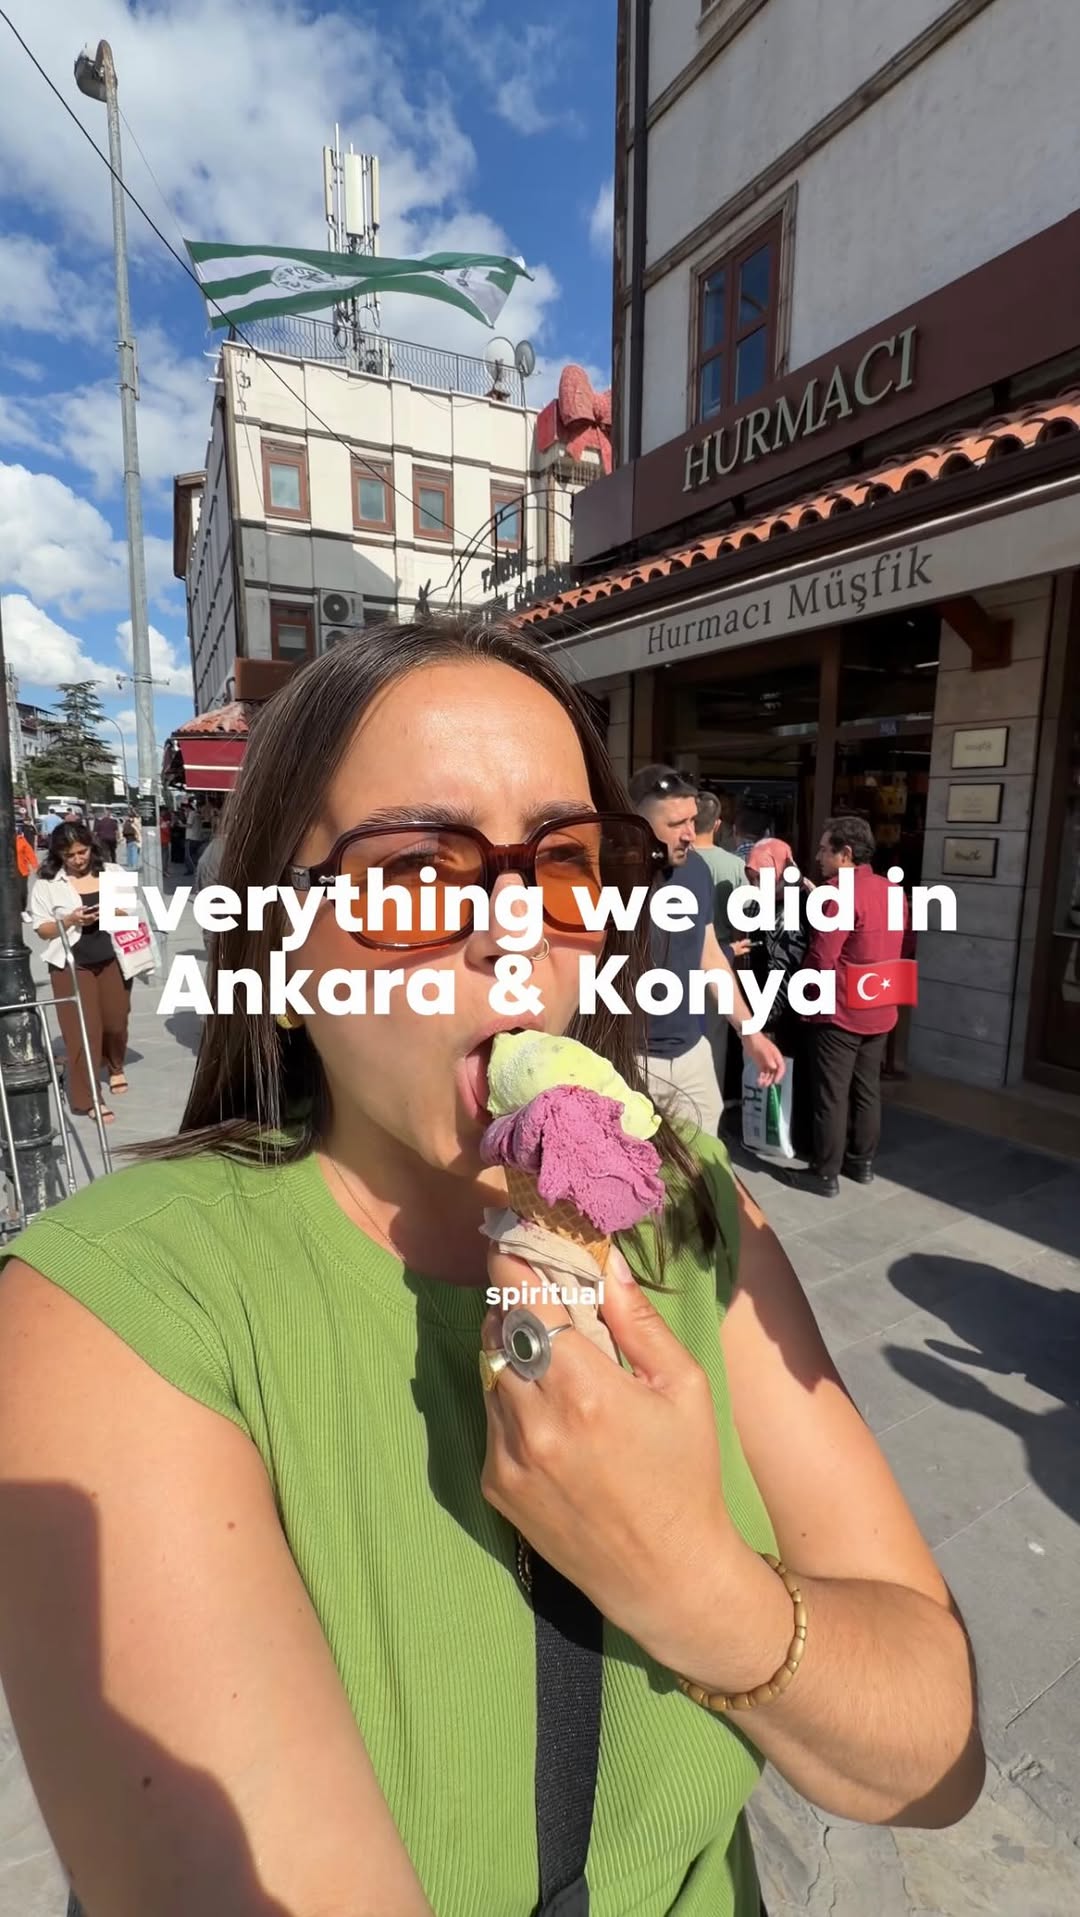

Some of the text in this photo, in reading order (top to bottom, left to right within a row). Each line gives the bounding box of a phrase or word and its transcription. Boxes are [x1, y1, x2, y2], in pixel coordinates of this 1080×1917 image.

[682, 325, 917, 492] HURMACI
[647, 545, 933, 655] Hurmacı Müşfik
